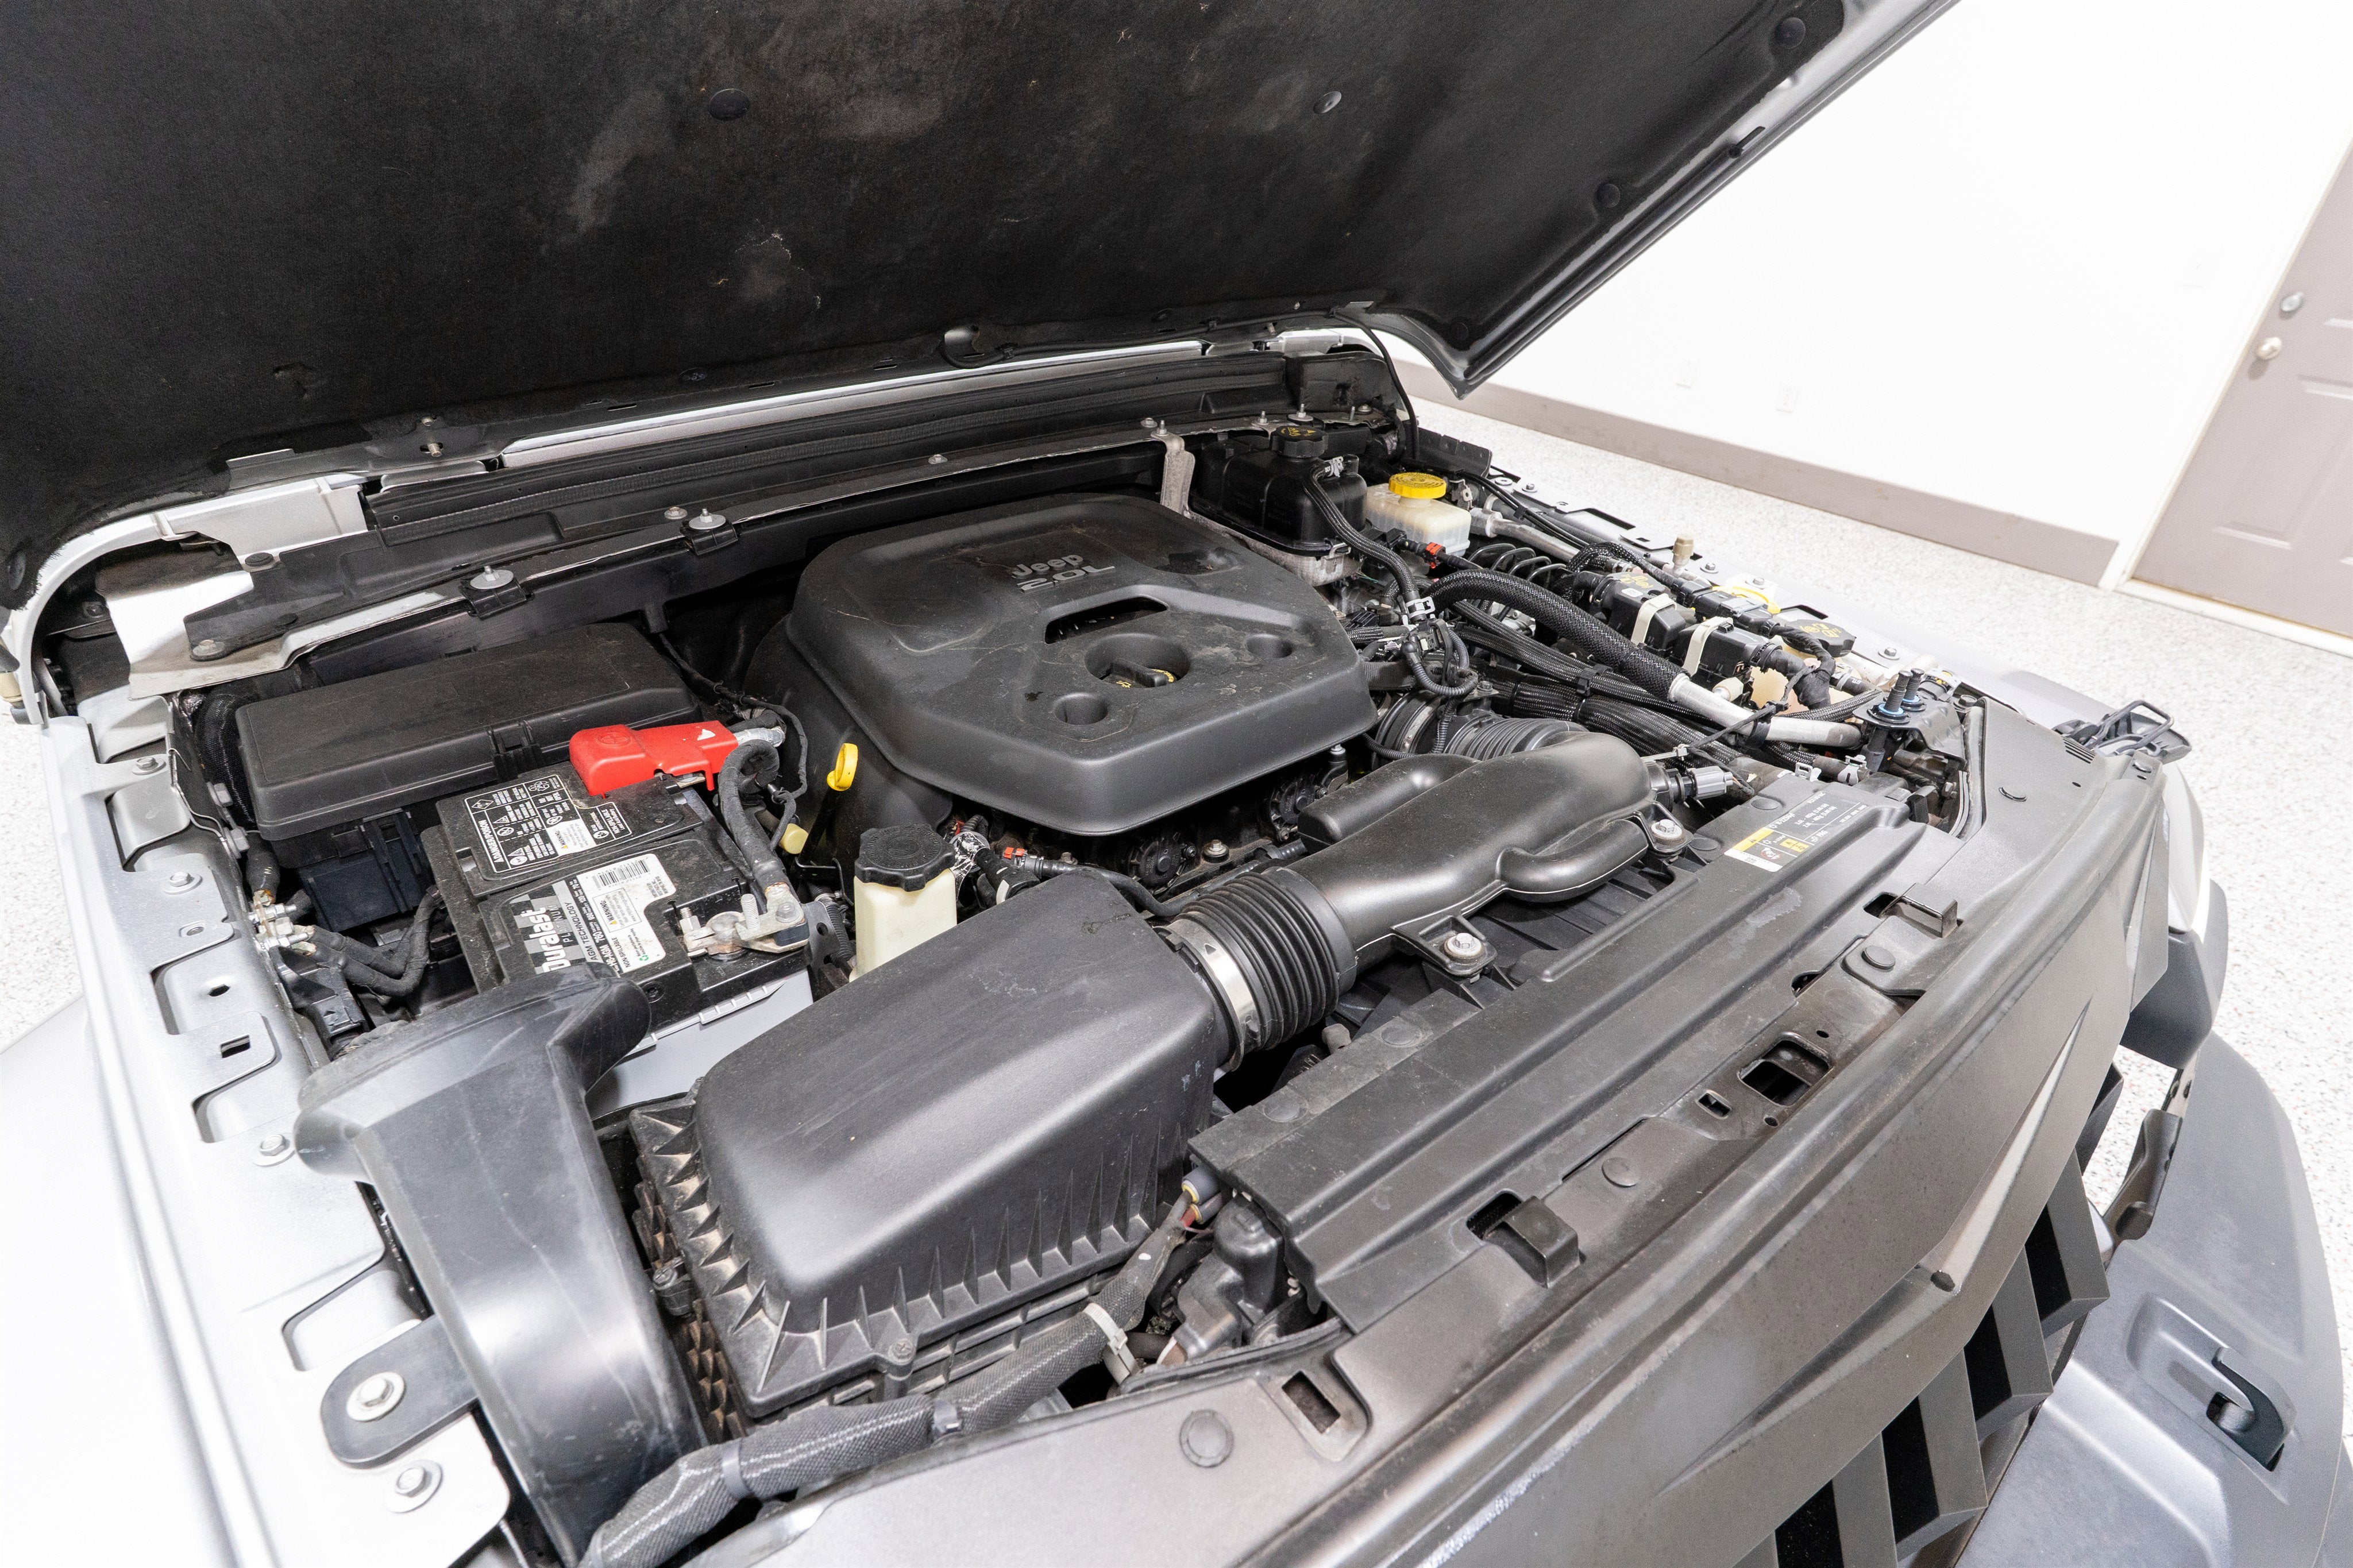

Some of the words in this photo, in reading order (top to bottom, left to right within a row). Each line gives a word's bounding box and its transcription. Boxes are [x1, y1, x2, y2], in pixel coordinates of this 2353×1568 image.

[1011, 554, 1083, 579] Jeep
[1016, 565, 1116, 593] 2.0L
[601, 808, 620, 834] NON-SPILLABLE
[477, 819, 502, 859] DANGER/POISON
[577, 894, 587, 903] 120
[598, 899, 615, 921] WARNING:
[547, 903, 574, 944] PLATINUM
[564, 900, 591, 944] TECHNOLOGY
[518, 905, 572, 974] Duralast
[592, 930, 606, 943] 760
[584, 944, 599, 962] AGM
[599, 943, 618, 967] H6-AGM
[611, 936, 631, 968] NON-SPILLABLE
